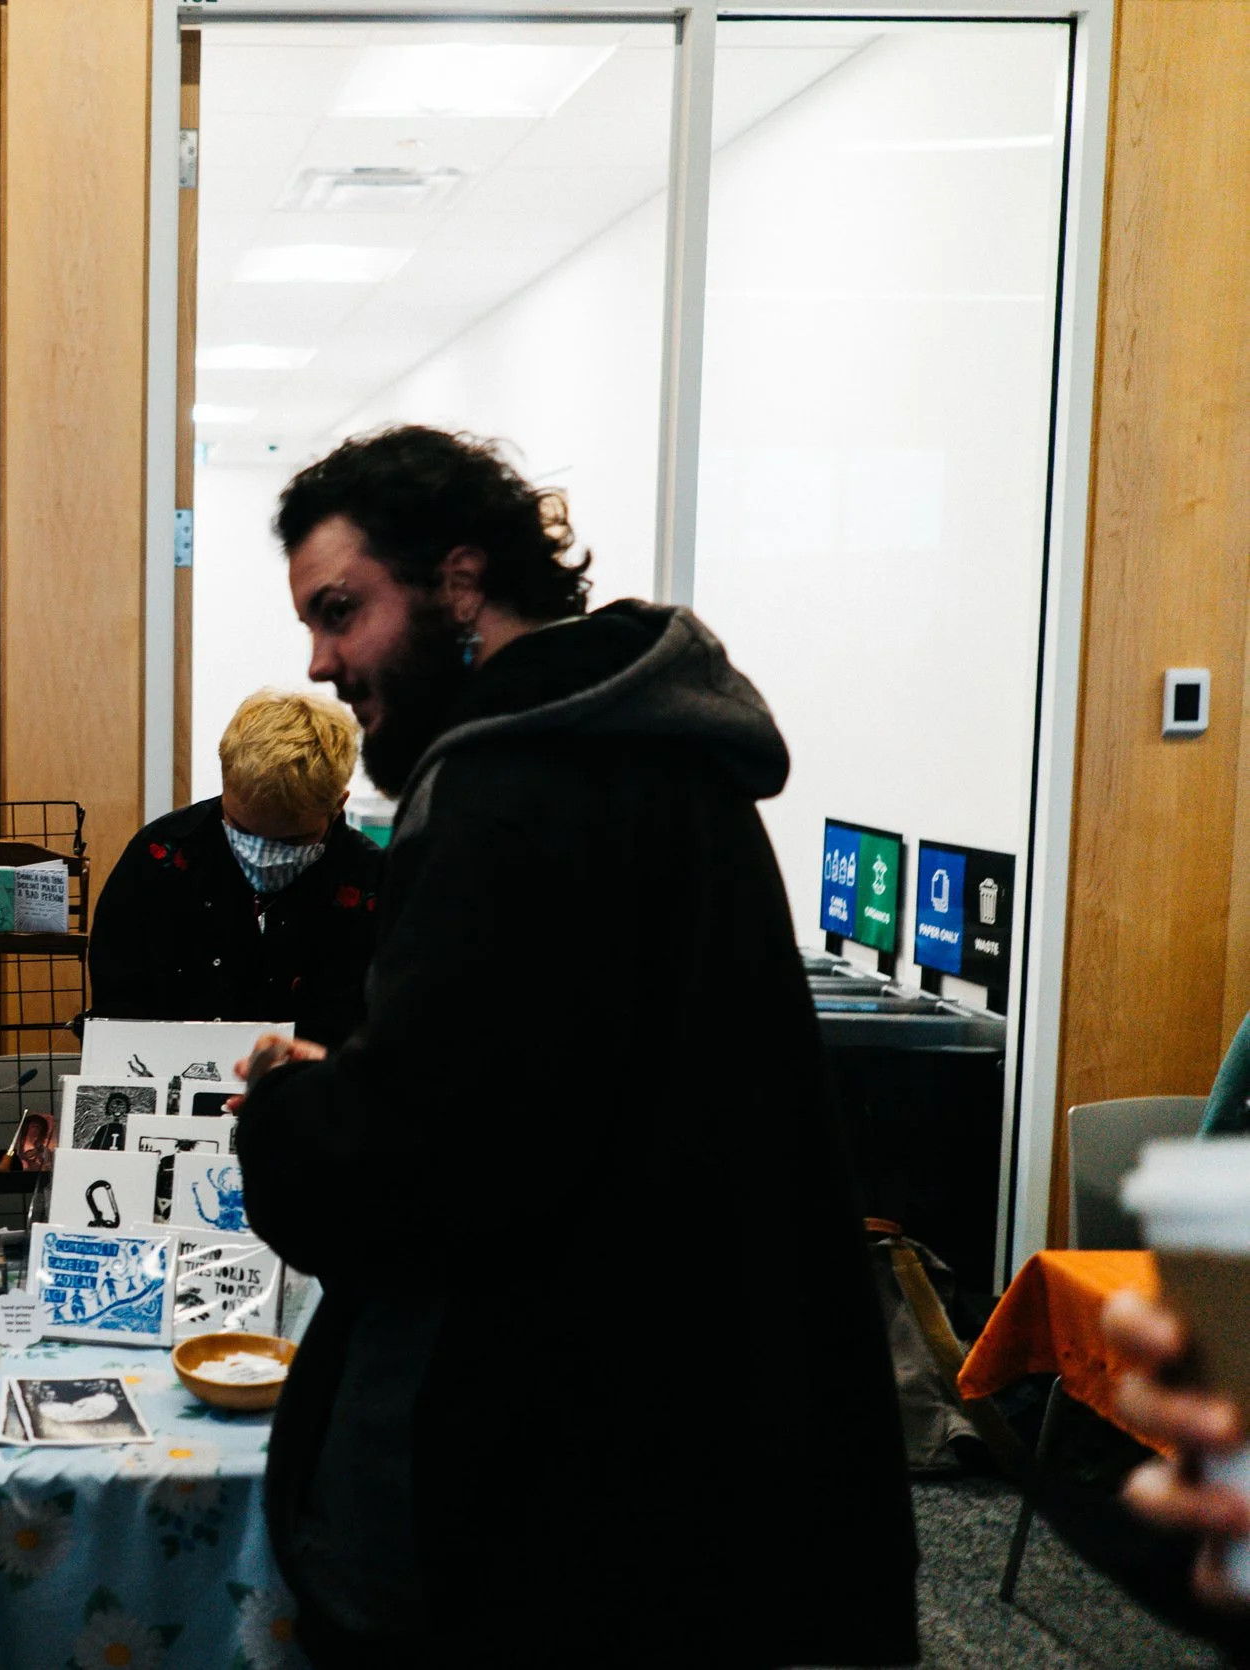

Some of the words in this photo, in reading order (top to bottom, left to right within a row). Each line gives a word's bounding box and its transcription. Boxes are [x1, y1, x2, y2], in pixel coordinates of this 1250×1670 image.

[18, 889, 23, 897] A
[26, 890, 39, 899] BAD
[40, 892, 64, 903] PERSON
[41, 884, 57, 892] MAKE
[58, 886, 64, 894] U
[919, 923, 940, 940] PAPER
[940, 928, 959, 944] ONLY
[974, 938, 1000, 956] WASTE
[76, 1259, 86, 1271] IS
[88, 1261, 98, 1272] A
[52, 1273, 94, 1288] ADICAL
[214, 1266, 244, 1282] WORLD
[248, 1268, 262, 1284] IS
[45, 1290, 65, 1302] ACT
[214, 1282, 234, 1296] TOO
[236, 1284, 264, 1298] MUCH
